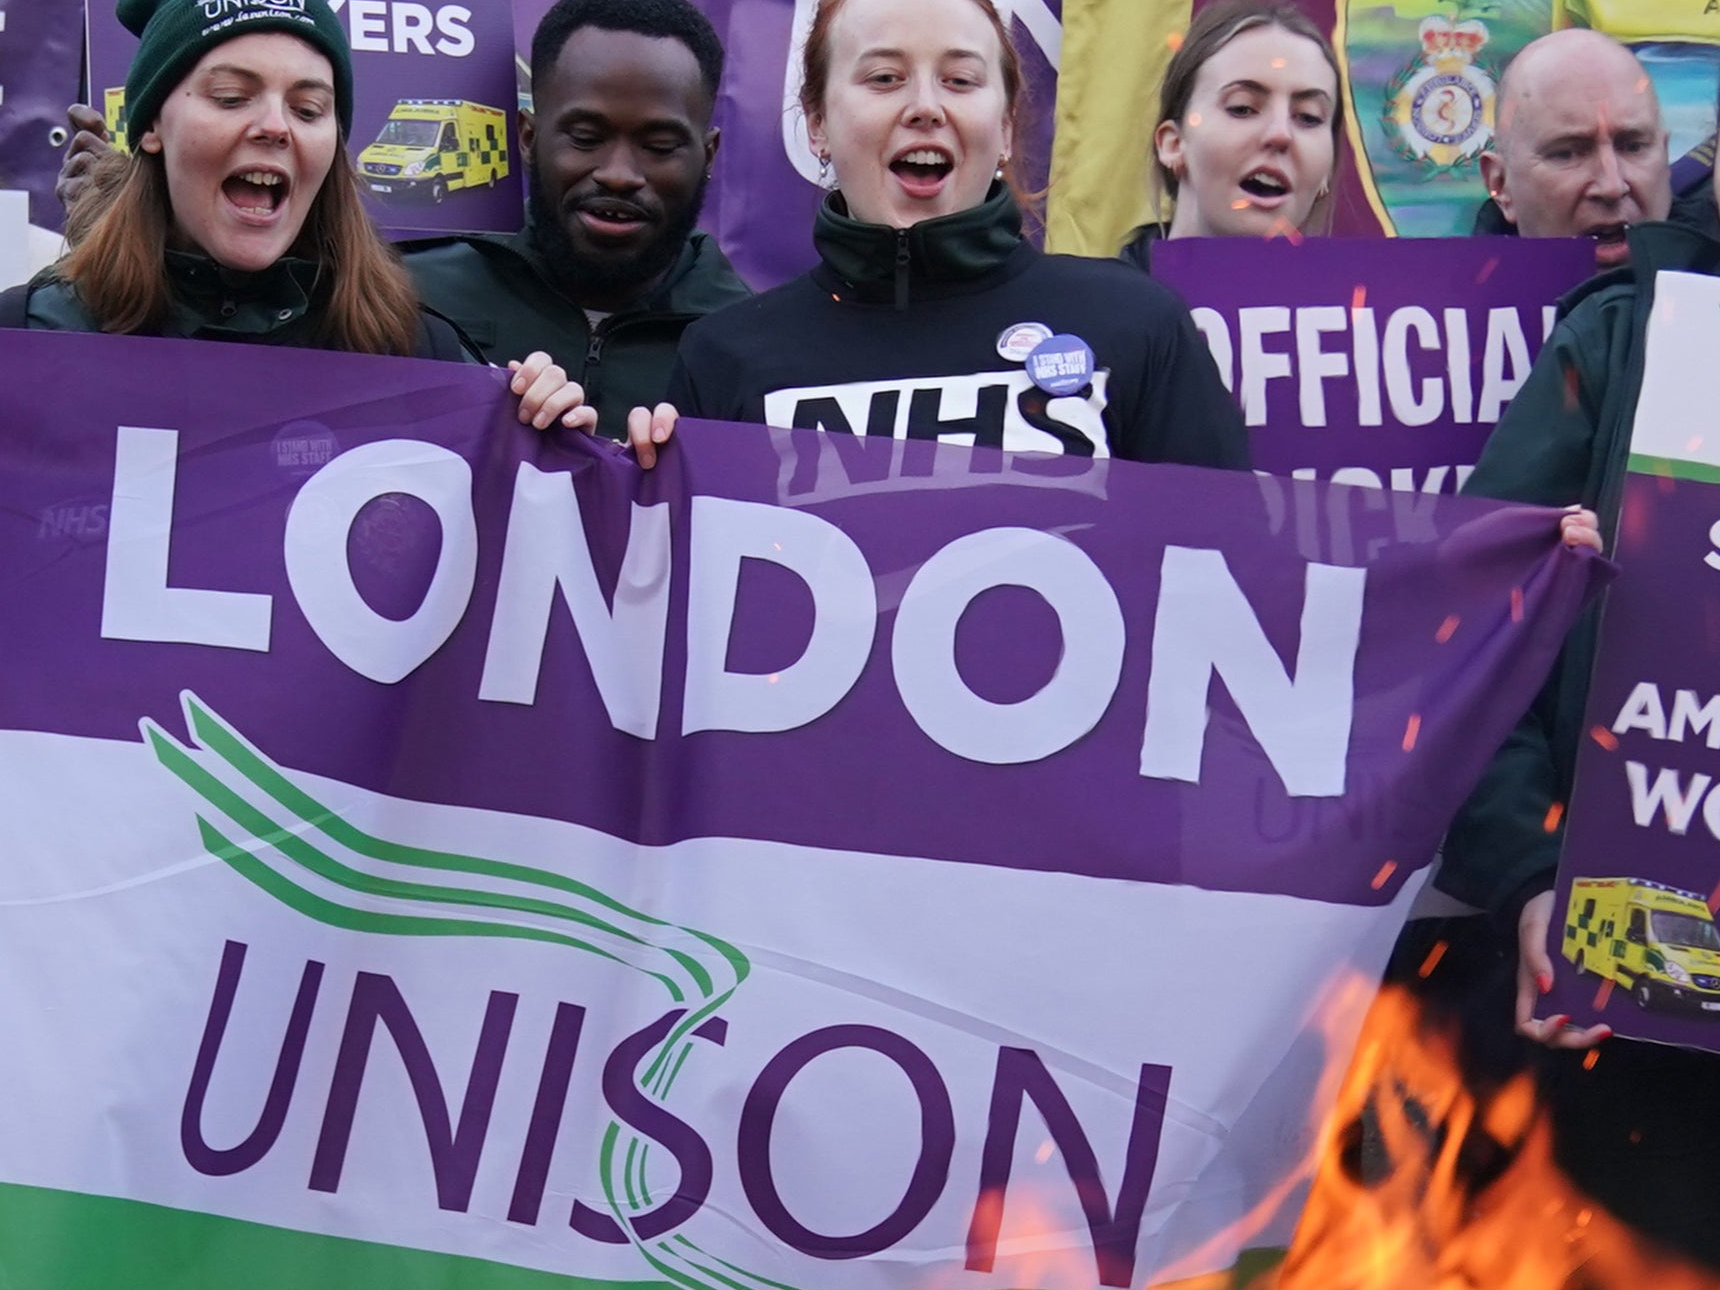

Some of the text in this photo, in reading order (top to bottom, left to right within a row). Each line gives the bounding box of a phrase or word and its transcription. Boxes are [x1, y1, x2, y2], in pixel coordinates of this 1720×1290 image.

[100, 425, 1366, 799] LONDON
[788, 383, 1097, 497] NHS
[179, 939, 1173, 1290] UNISON
